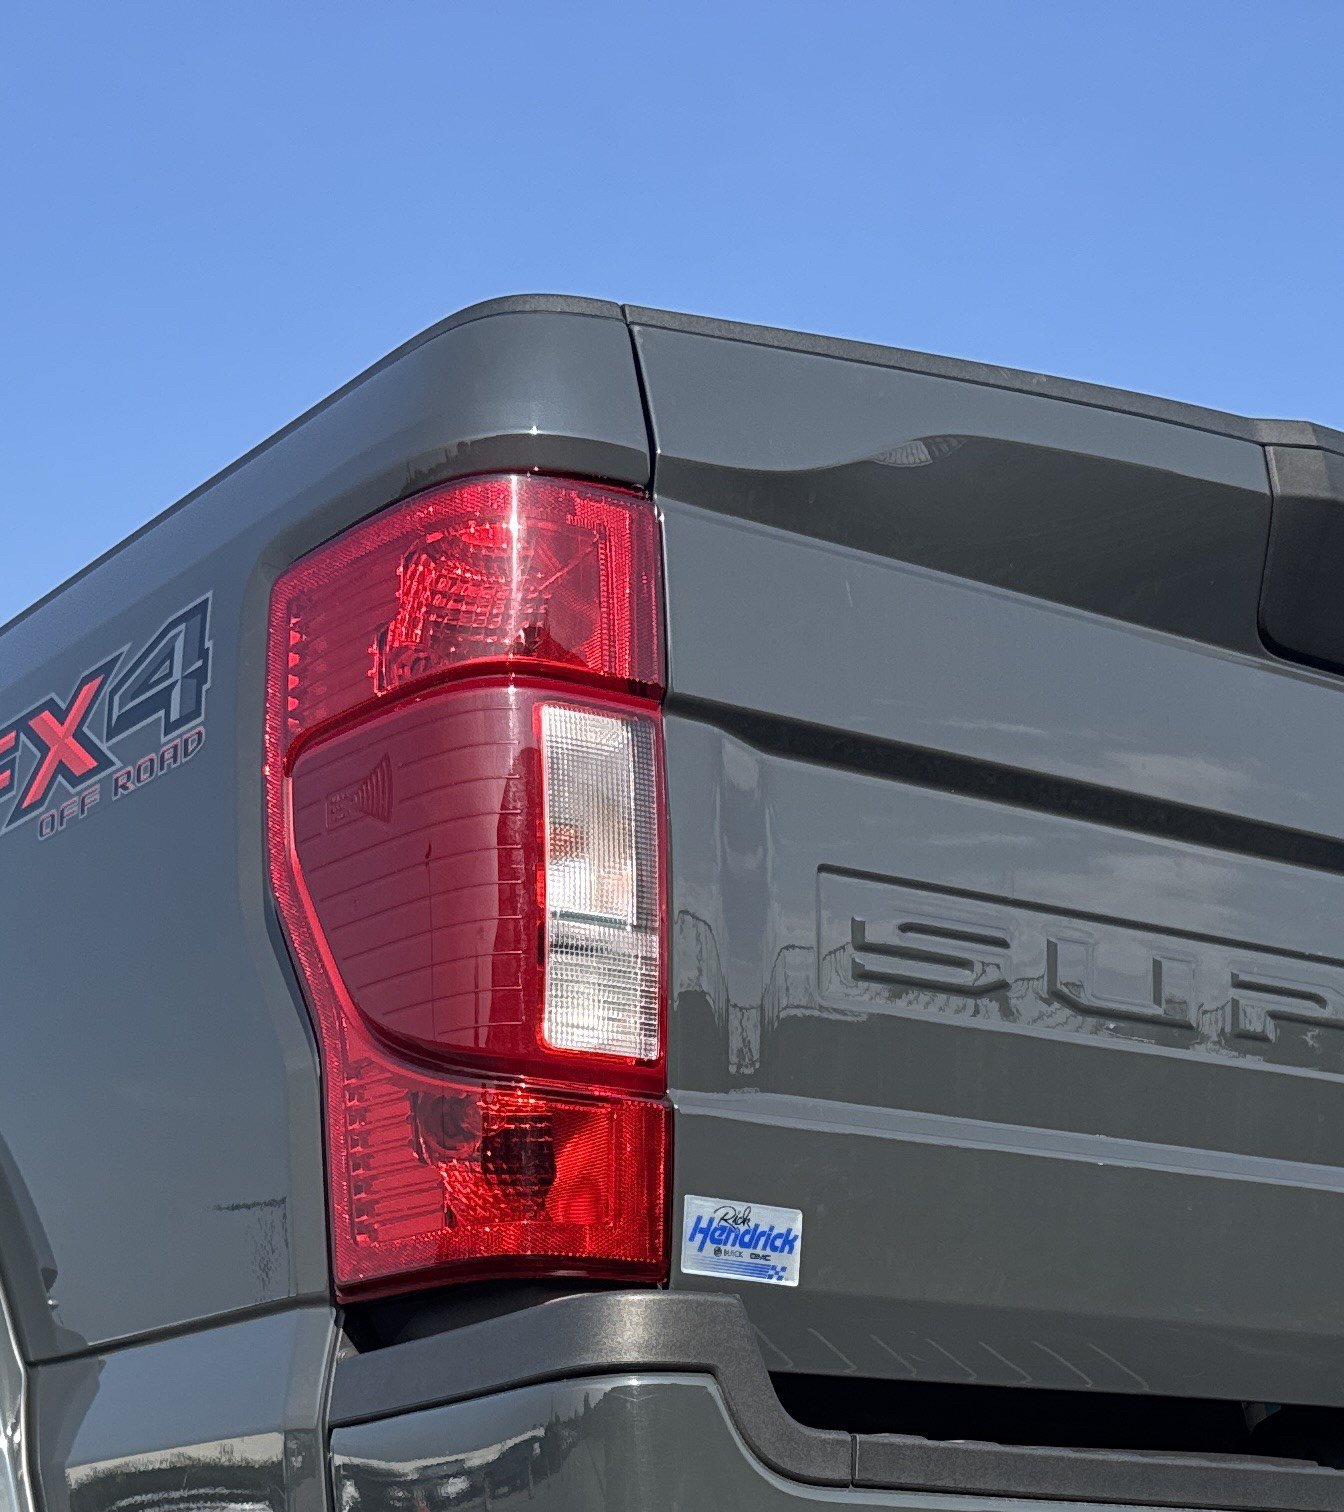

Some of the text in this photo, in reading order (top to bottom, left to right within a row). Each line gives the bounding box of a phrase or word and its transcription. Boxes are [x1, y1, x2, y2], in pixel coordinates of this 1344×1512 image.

[37, 726, 206, 841] OFF ROAD
[688, 1214, 800, 1256] Hendrick
[713, 1205, 753, 1230] Rick
